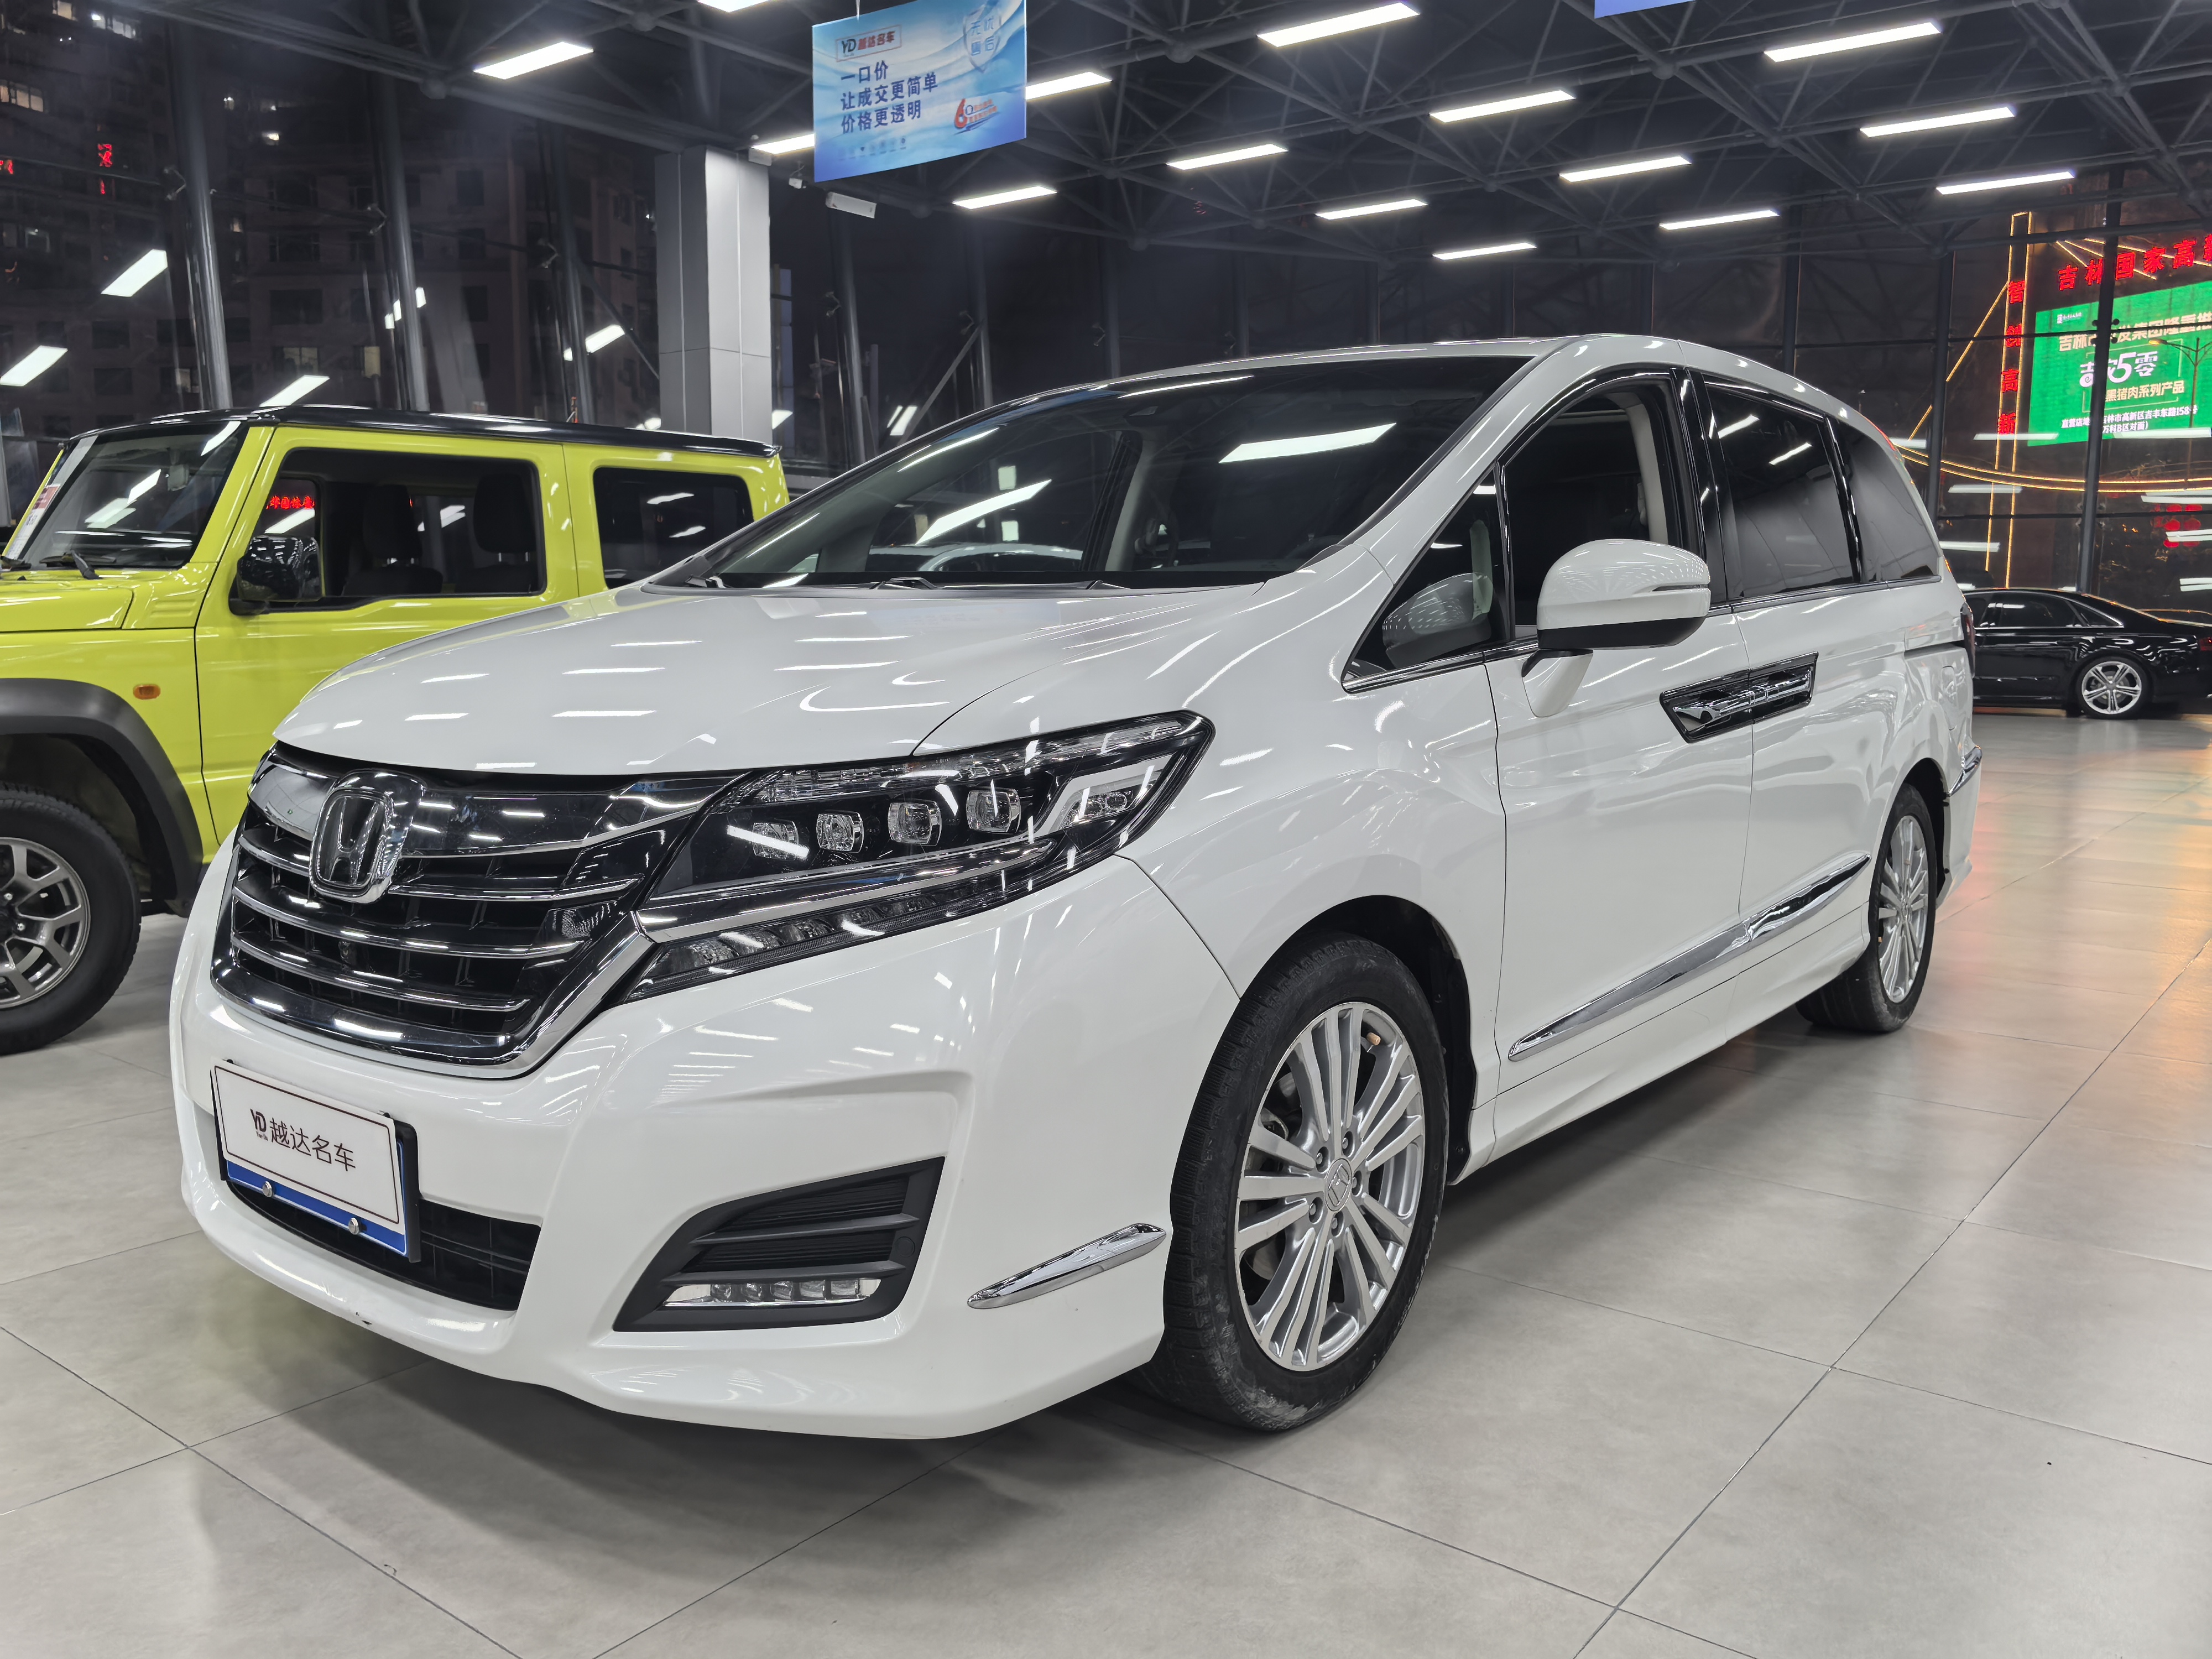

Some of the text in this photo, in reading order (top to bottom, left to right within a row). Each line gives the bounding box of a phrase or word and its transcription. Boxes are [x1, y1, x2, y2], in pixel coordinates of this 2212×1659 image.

[841, 60, 889, 84] 一口价
[841, 72, 938, 111] 让成交更简单
[841, 100, 922, 134] 价格更透明
[2059, 311, 2212, 352] 吉林发集团隆重推
[1997, 280, 2026, 435] 智创高新
[2105, 380, 2185, 402] 黑猪肉系列产品
[250, 1108, 356, 1172] YD 越达名车
